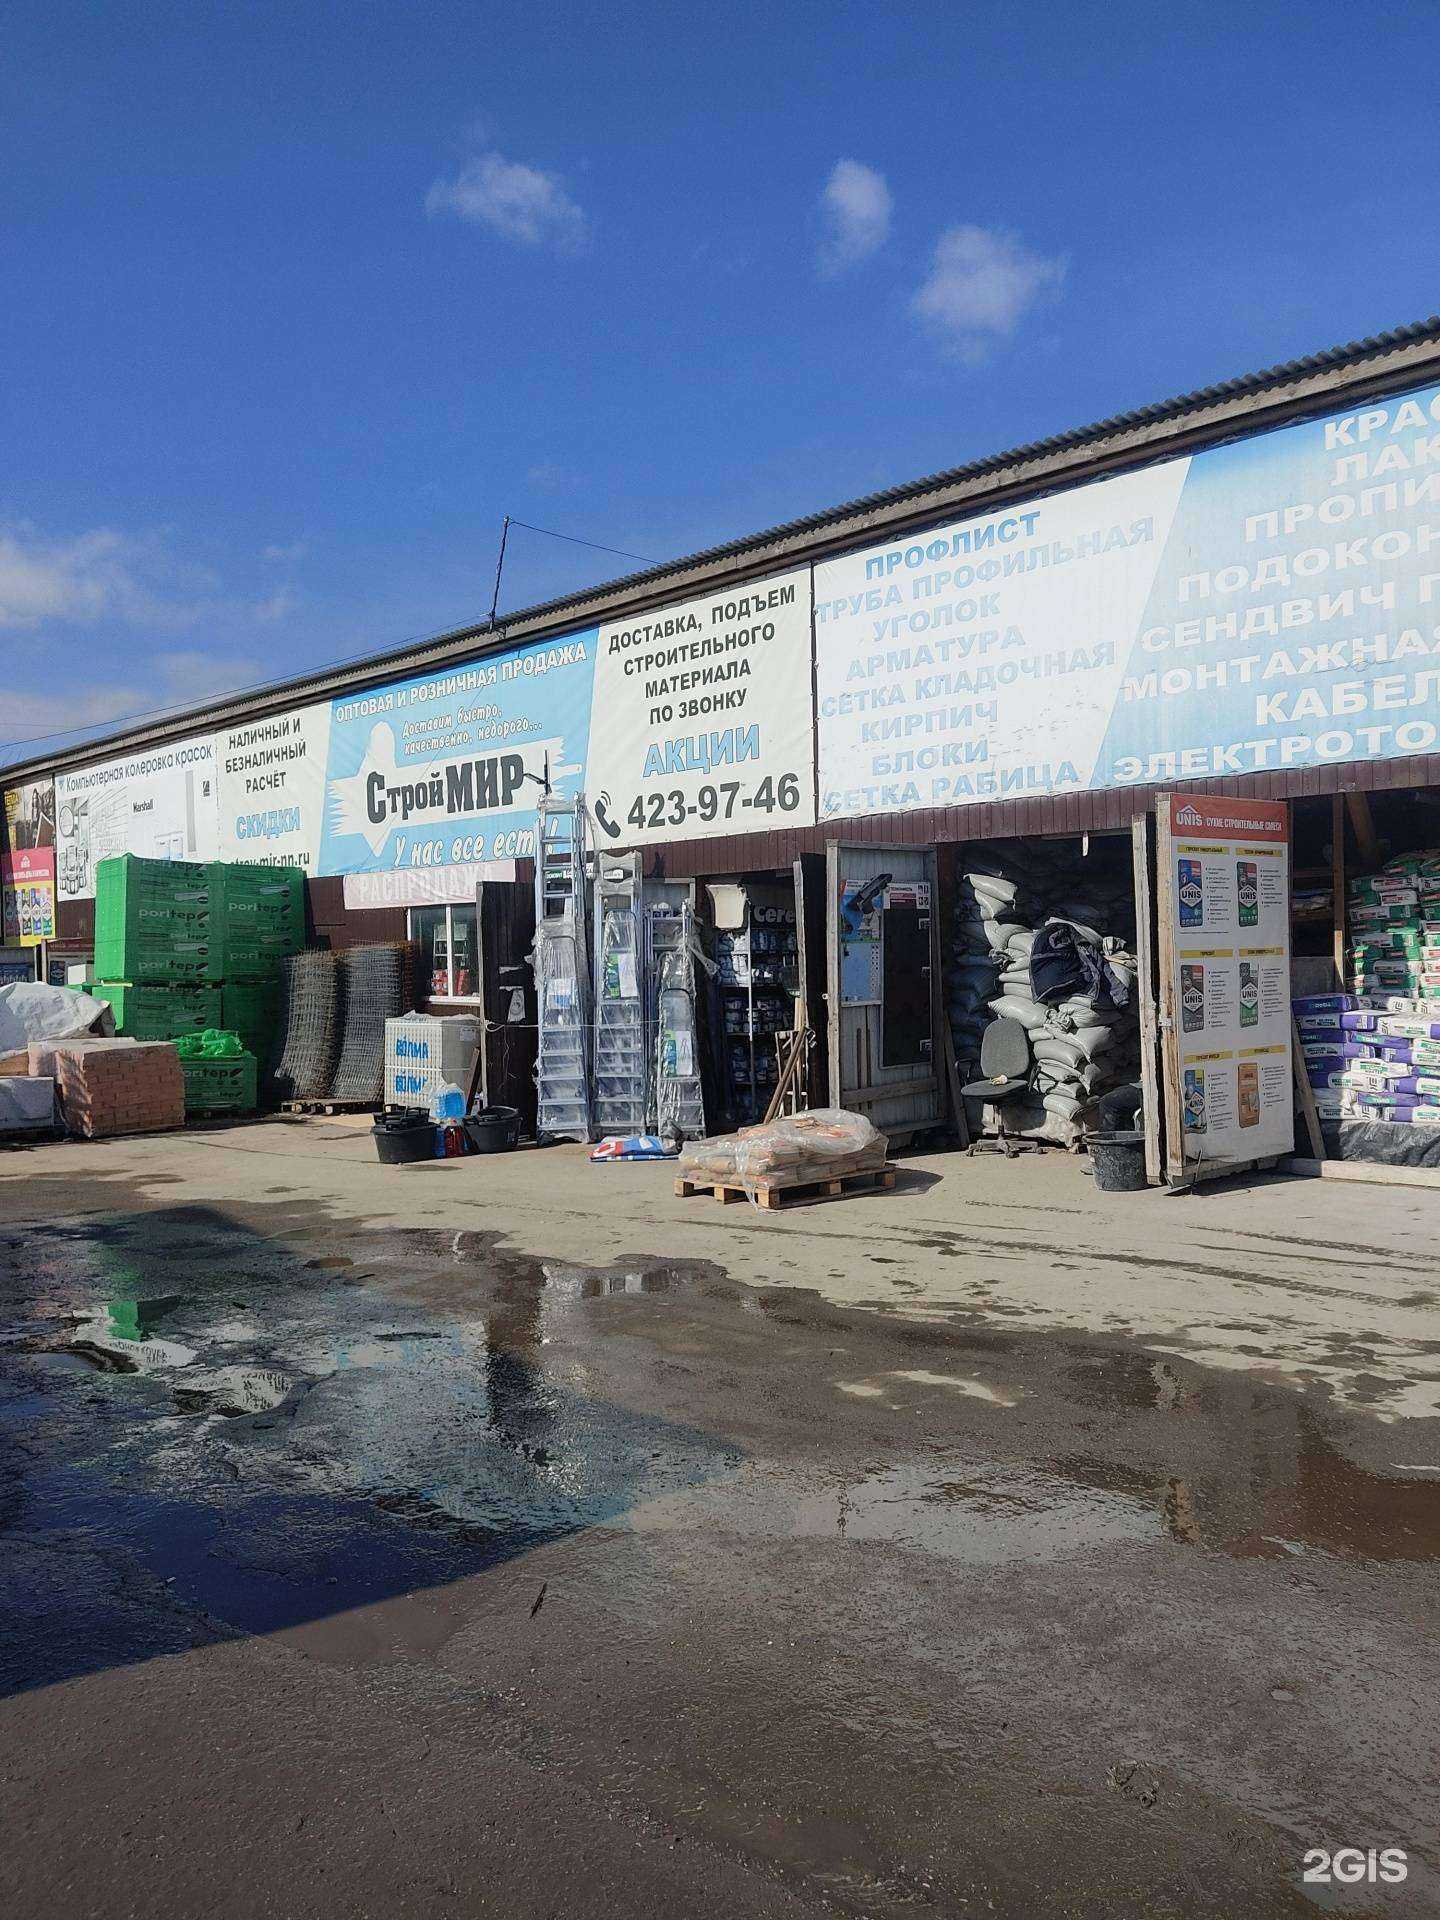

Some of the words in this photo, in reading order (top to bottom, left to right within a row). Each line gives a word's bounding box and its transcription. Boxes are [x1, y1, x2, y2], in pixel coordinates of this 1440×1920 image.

[1325, 395, 1440, 450] КРА
[1245, 473, 1440, 543] ПРОПИ
[865, 510, 1041, 581] ПРОФЛИСТ
[816, 584, 903, 624] ТРУБА
[912, 517, 1154, 601] ПРОФИЛЬНАЯ
[608, 613, 702, 655] ДОСТАВКА,
[711, 584, 796, 625] ПОДЪЕМ
[873, 592, 1001, 642] УГОЛОК
[1142, 581, 1396, 653] СЕНДВИЧ
[623, 622, 776, 676] СТРОИТЕЛЬНОГО
[846, 625, 1026, 681] АРМАТУРА
[1123, 625, 1440, 702] МОНТАЖНА
[336, 692, 394, 723] ОПТОВАЯ
[397, 688, 407, 709] И
[410, 668, 497, 705] РОЗНИЧНАЯ
[501, 641, 588, 680] ПРОДАЖА
[645, 658, 752, 699] МАТЕРИАЛА
[821, 682, 907, 718] СЕТКА
[914, 640, 1115, 701] КЛАДОЧНАЯ
[1256, 669, 1440, 727] КАБЕЛ
[401, 713, 453, 740] Доставим
[457, 703, 503, 723] быстро,
[477, 717, 543, 741] недорого...
[649, 704, 674, 725] ПО
[678, 688, 748, 720] ЗВОНКУ
[861, 700, 999, 744] КИРПИЧ
[225, 738, 307, 774] БЕЗНАЛИЧНЫЙ
[228, 717, 290, 750] НАЛИЧНЫЙ
[293, 717, 301, 733] И
[643, 723, 760, 777] АКЦИИ
[871, 739, 989, 777] БЛОКИ
[1113, 720, 1437, 783] ЭЛЕКТРОТО
[66, 766, 124, 793] Компьютерная
[124, 753, 173, 778] колеровка
[175, 744, 213, 765] красок
[246, 770, 287, 794] РАСЧЁТ
[366, 753, 524, 824] СтройМИР
[824, 780, 921, 813] СЕТКА
[930, 759, 1081, 800] РАБИЦА
[132, 798, 154, 813] Marshall
[235, 806, 301, 840] СКИДКИ
[627, 772, 800, 830] 423-97-46
[1176, 811, 1203, 826] UNIS
[230, 851, 310, 867] troy-mir-nn.ru
[394, 834, 407, 868] У
[411, 839, 444, 868] нас
[452, 833, 485, 863] все
[1181, 890, 1202, 900] UNIS
[1240, 890, 1257, 901] UNIS
[1184, 993, 1203, 1004] UNIS
[1242, 988, 1258, 999] UNIS
